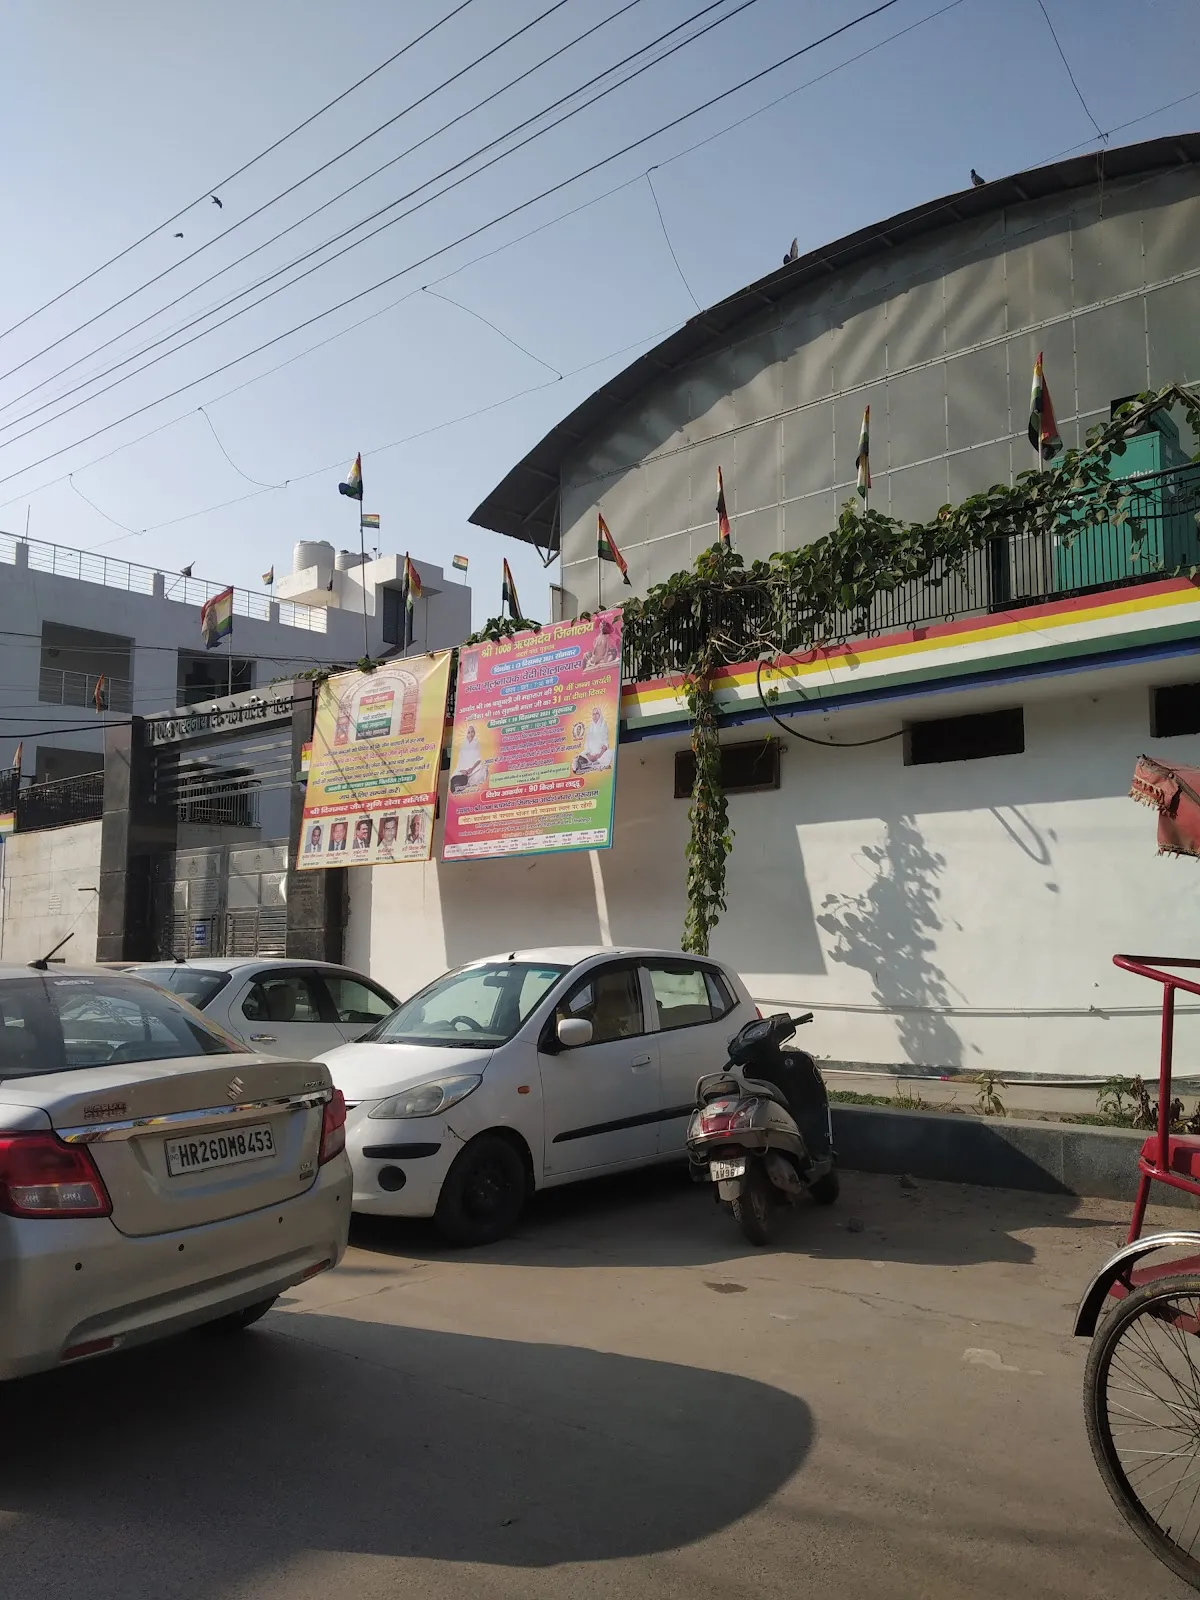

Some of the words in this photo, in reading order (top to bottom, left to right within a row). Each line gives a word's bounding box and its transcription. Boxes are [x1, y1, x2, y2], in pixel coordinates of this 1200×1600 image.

[481, 644, 492, 658] श्री
[553, 622, 595, 641] जिनालय
[522, 669, 537, 681] वेदी
[554, 684, 564, 694] 90
[552, 695, 562, 704] 31
[528, 784, 538, 793] 90
[321, 804, 348, 814] दिगम्बर
[350, 802, 364, 810] जैन
[366, 800, 382, 811] मुनि
[384, 798, 400, 806] सेवा
[402, 794, 430, 805] समिति
[179, 1130, 272, 1167] HR26DM8453
